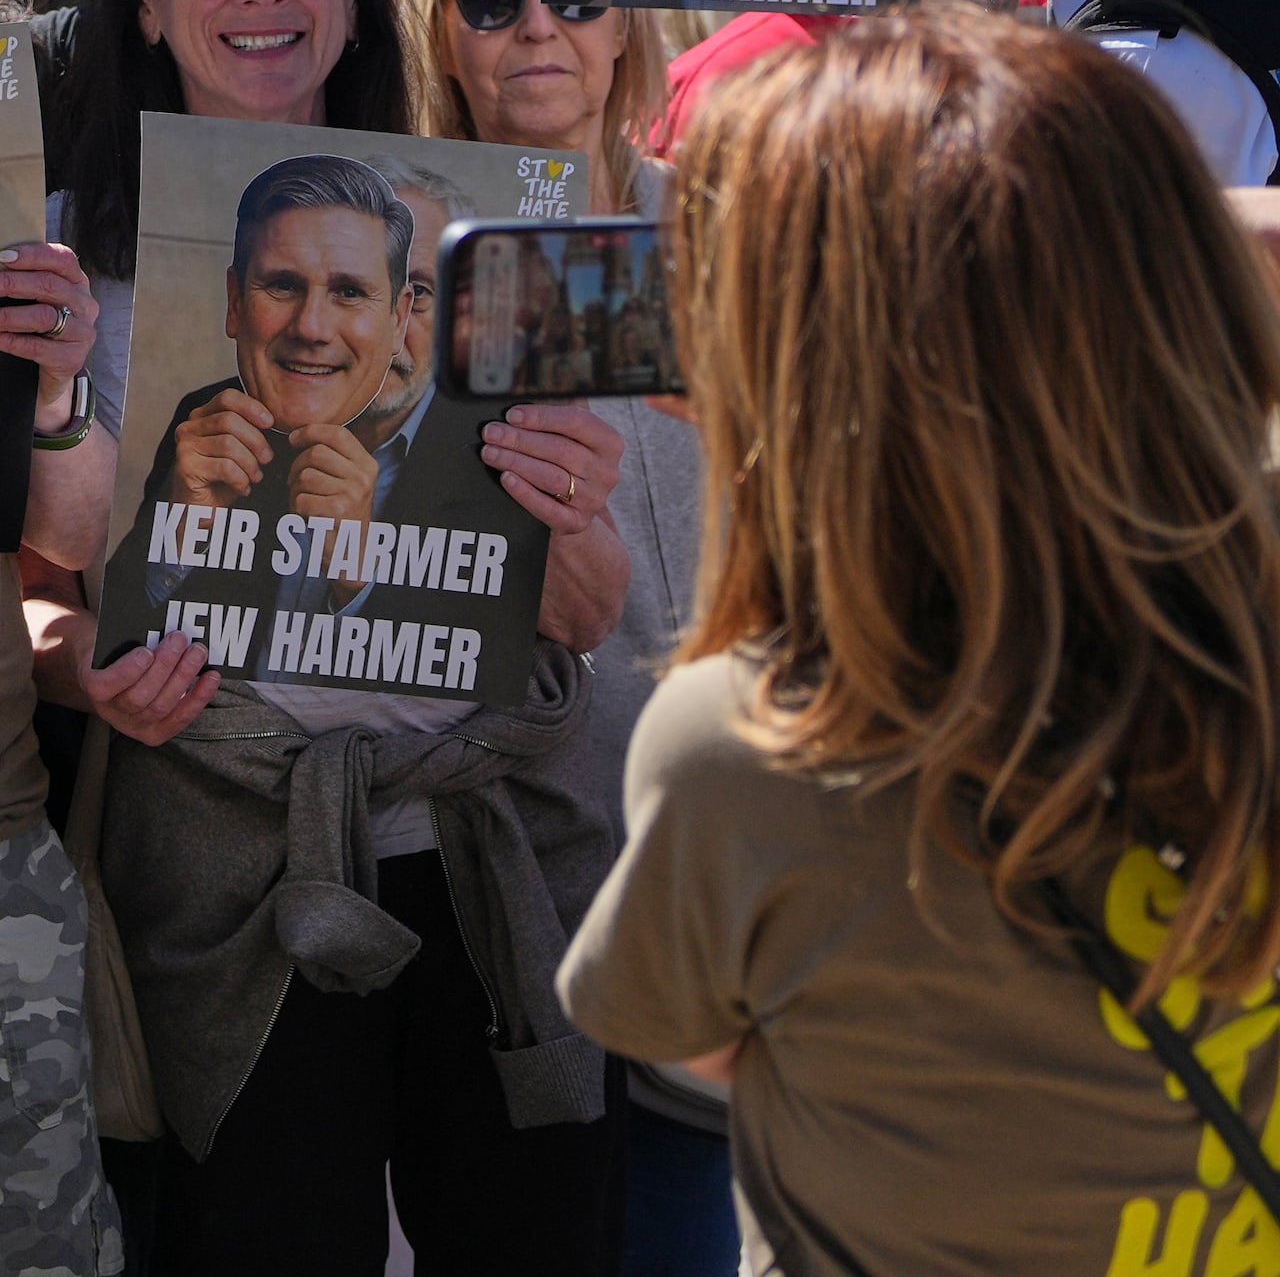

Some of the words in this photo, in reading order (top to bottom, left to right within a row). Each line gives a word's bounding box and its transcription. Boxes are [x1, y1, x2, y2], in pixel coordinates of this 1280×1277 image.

[518, 196, 569, 221] HATE
[524, 177, 566, 201] THE
[147, 501, 260, 572] KEIR
[271, 513, 509, 597] STARMER
[268, 610, 482, 691] HARMER
